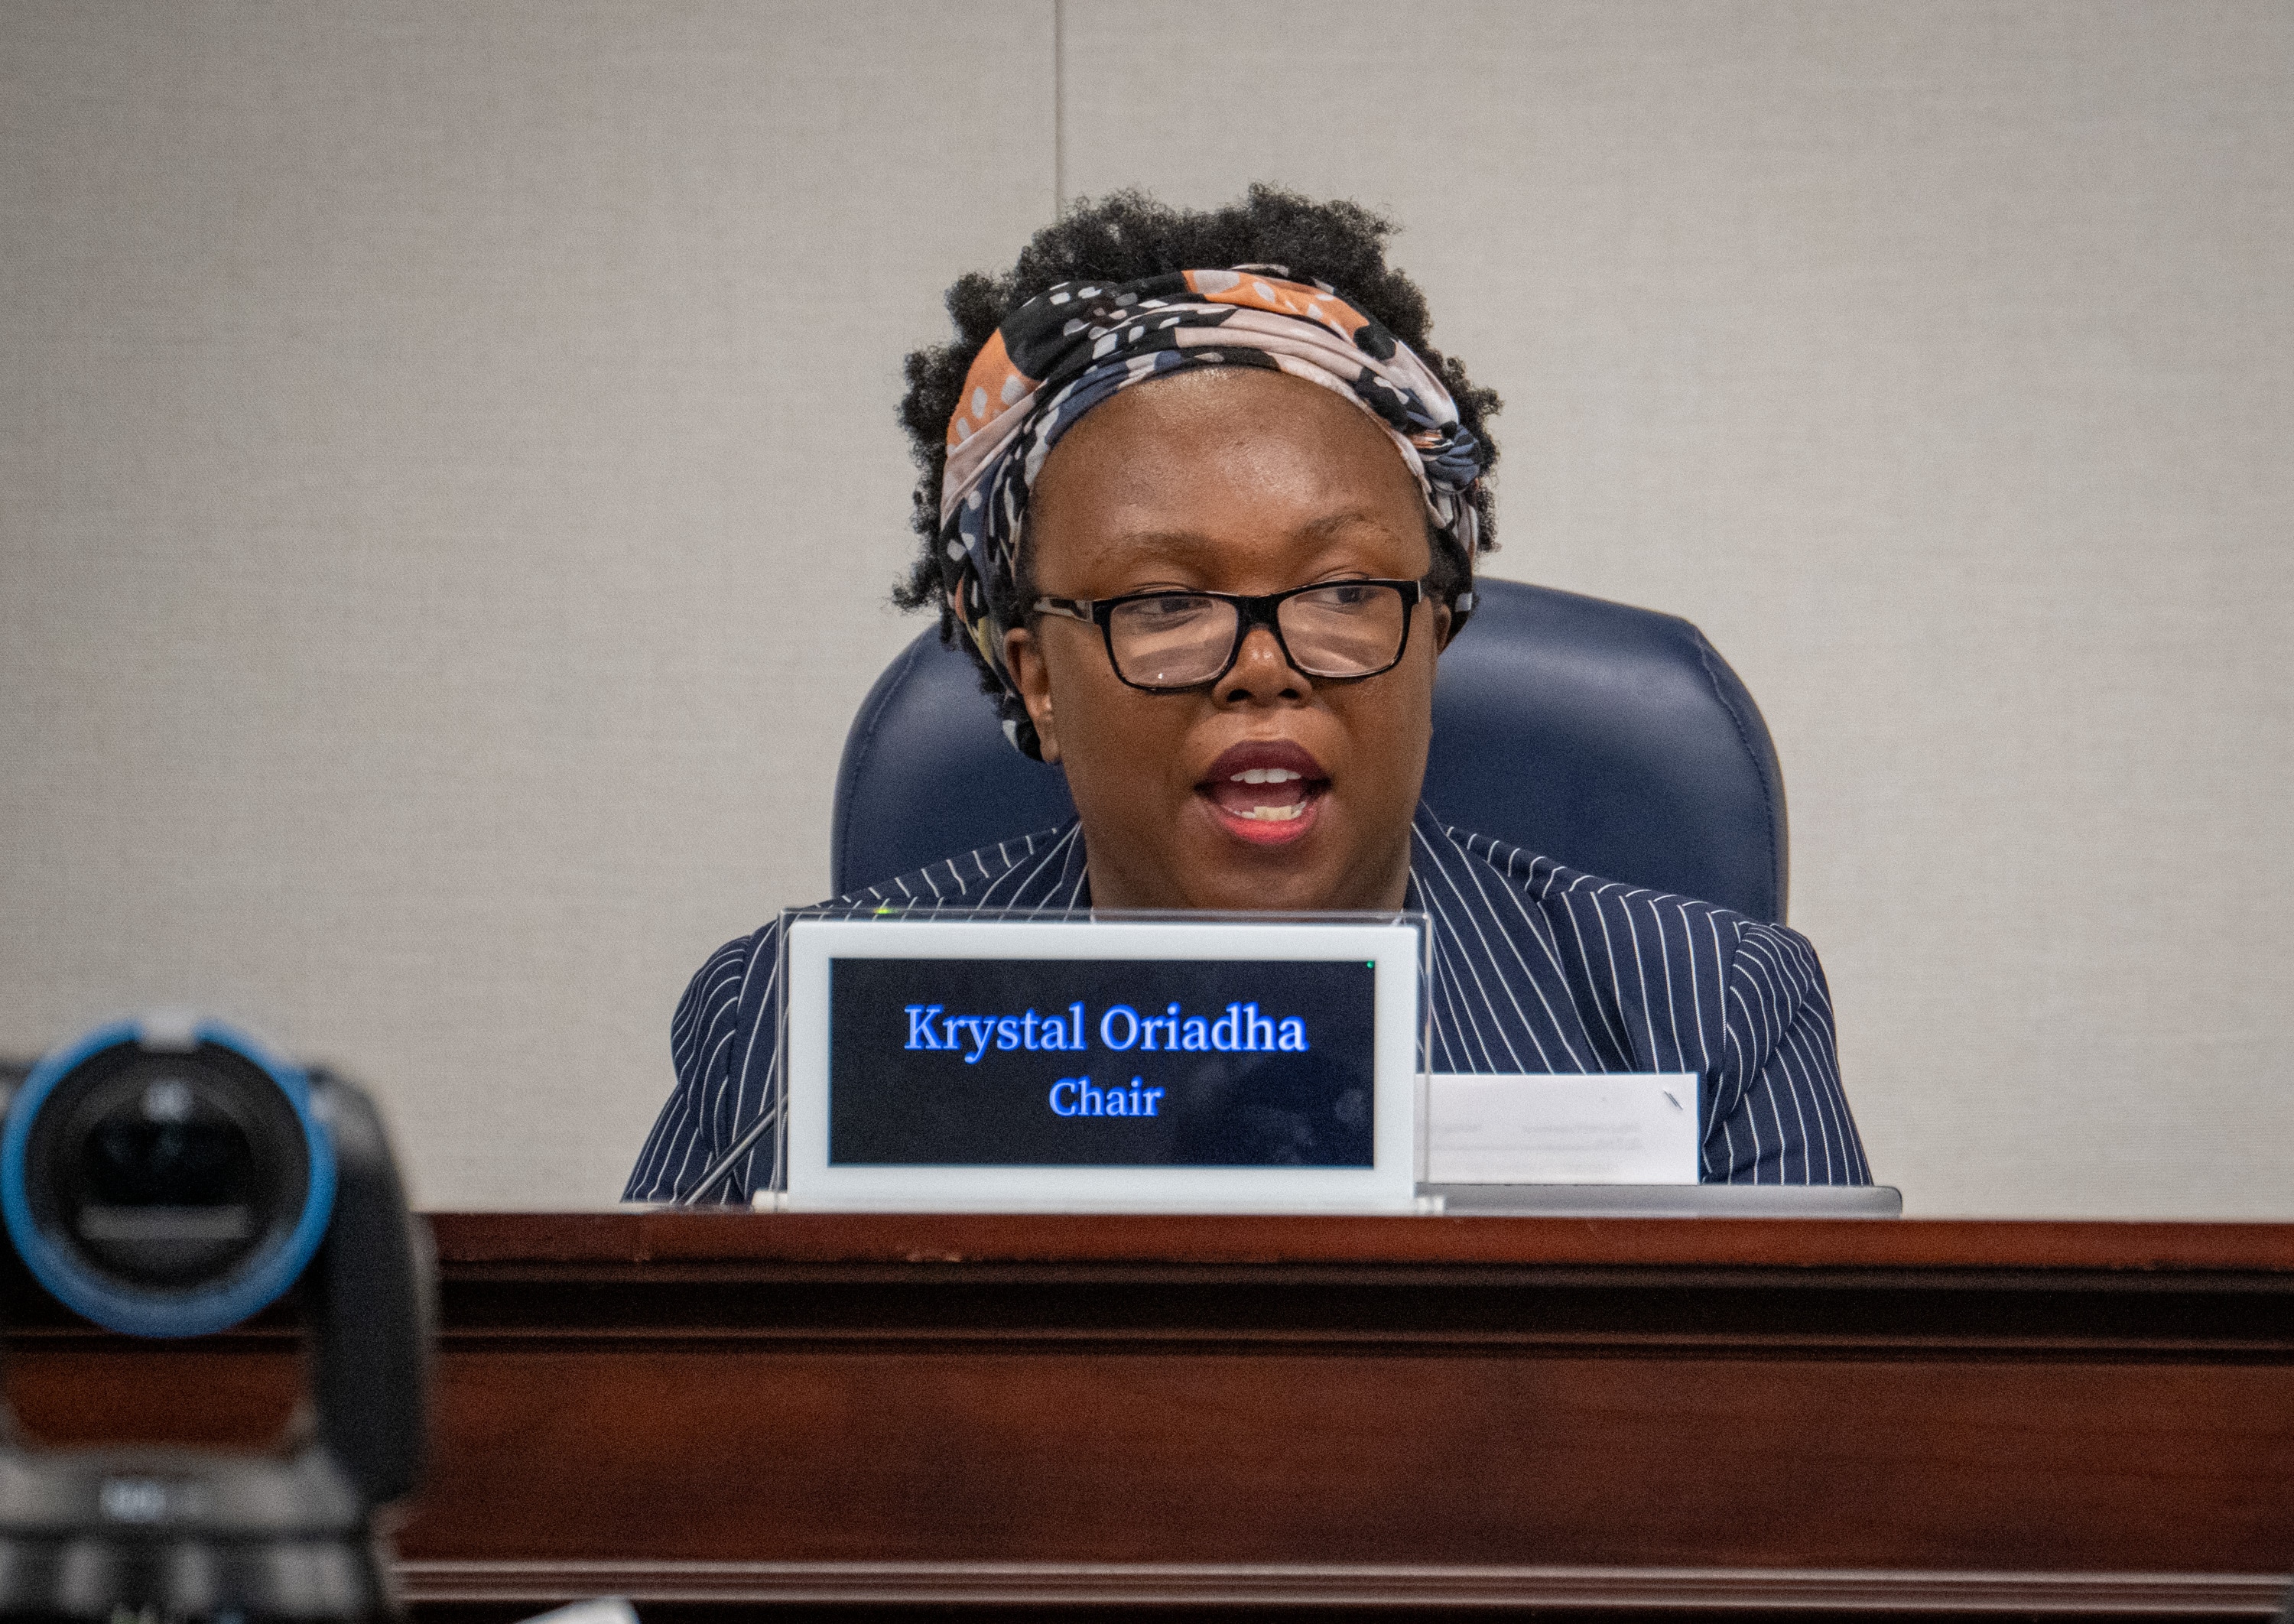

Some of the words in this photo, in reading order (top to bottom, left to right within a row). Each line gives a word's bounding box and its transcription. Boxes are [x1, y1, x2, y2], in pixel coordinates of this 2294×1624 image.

[904, 1001, 1087, 1064] Krystal
[1100, 1002, 1309, 1053] Oriadha
[1048, 1075, 1165, 1117] Chair
